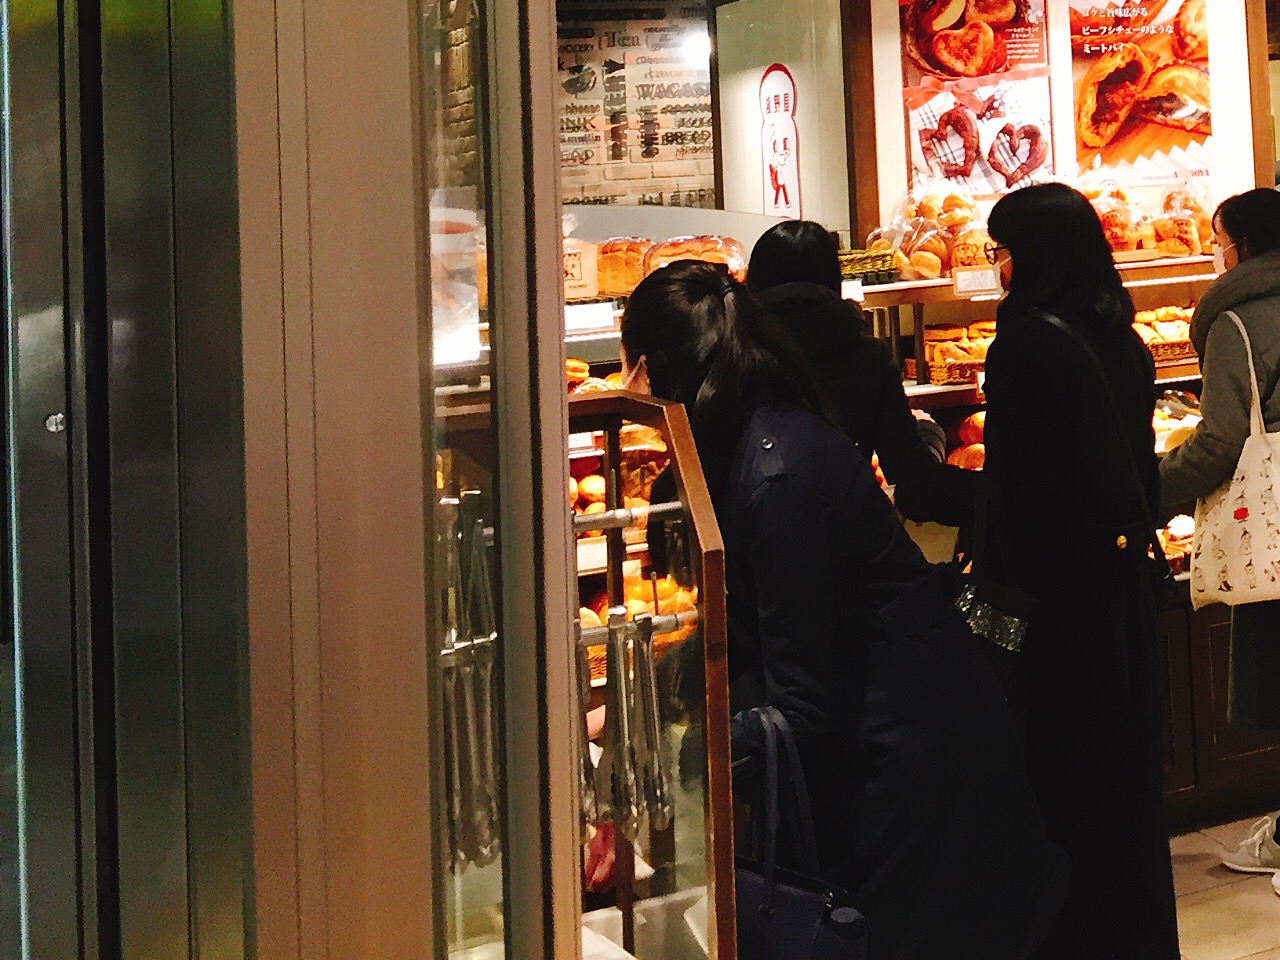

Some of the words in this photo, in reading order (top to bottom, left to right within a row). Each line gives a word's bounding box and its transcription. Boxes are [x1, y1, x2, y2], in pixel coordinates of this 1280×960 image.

[1081, 7, 1149, 17] コクと旨味広がる
[1081, 24, 1174, 35] ビーフシチューのような
[1083, 43, 1125, 54] ミートパイ
